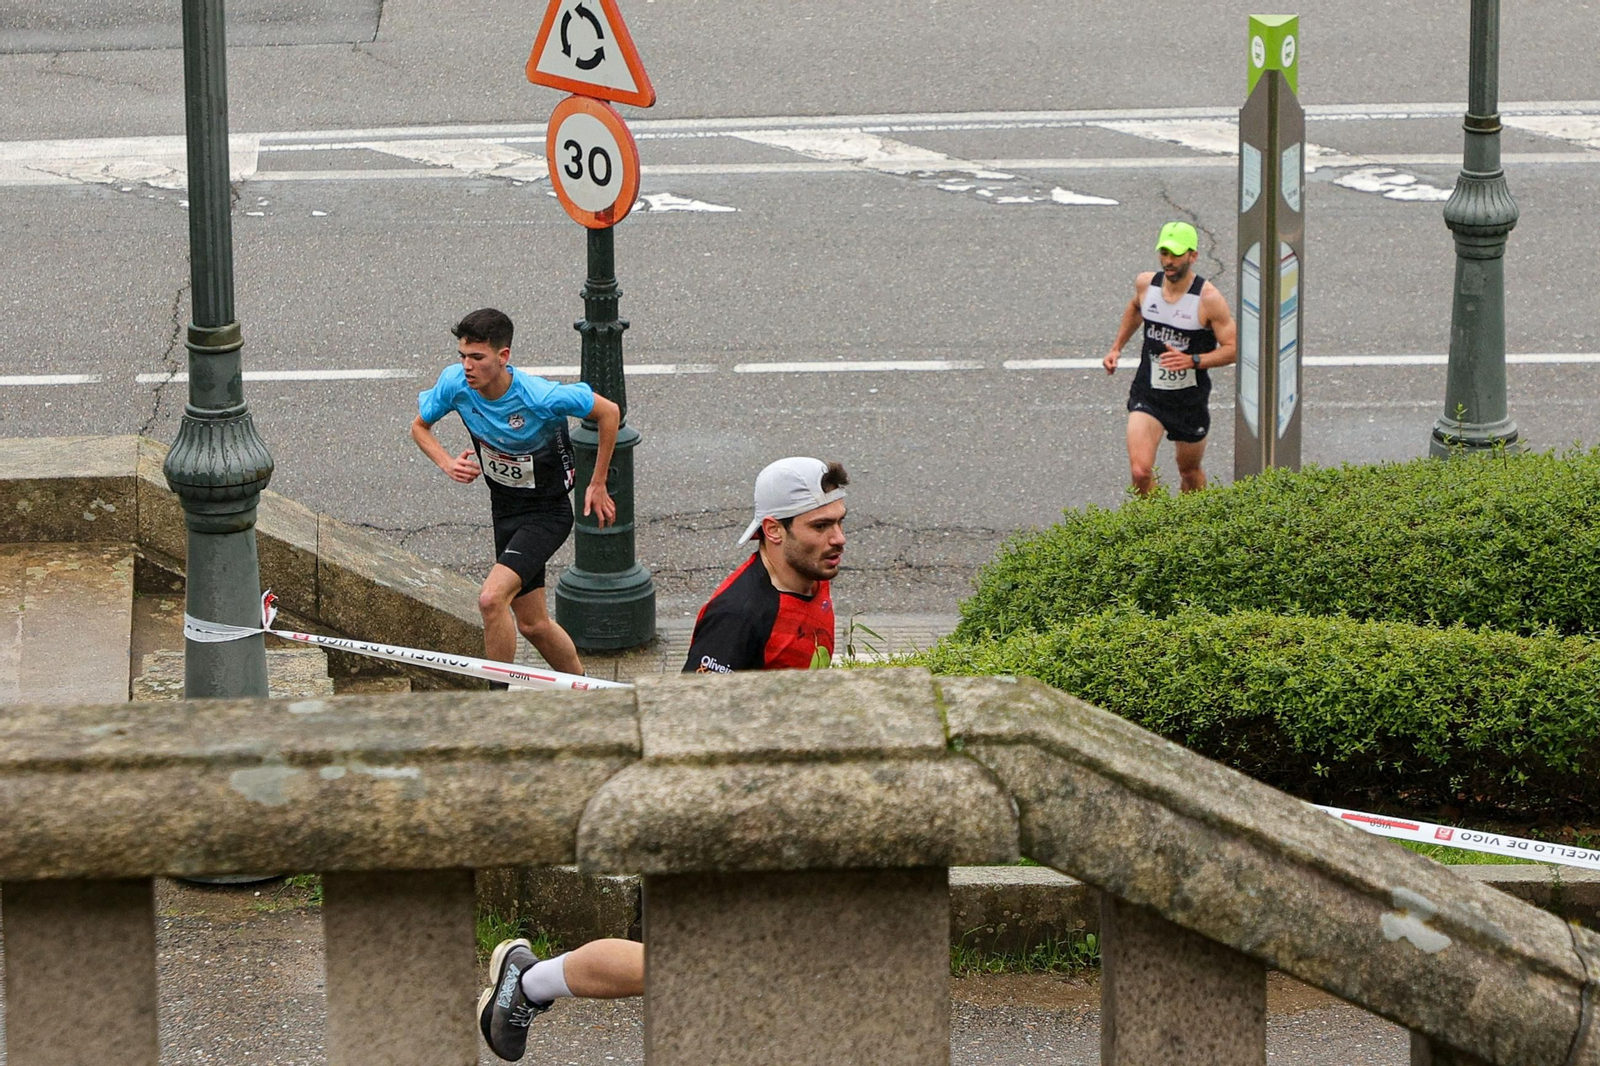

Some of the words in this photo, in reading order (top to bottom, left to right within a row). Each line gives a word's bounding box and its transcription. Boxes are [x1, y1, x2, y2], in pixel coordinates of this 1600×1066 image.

[564, 140, 612, 187] 30
[1159, 368, 1187, 381] 289
[488, 460, 522, 479] 428
[1369, 819, 1392, 830] VIGO
[1460, 832, 1500, 846] VIGO
[1506, 839, 1529, 850] DE
[497, 963, 520, 1008] HOKA
